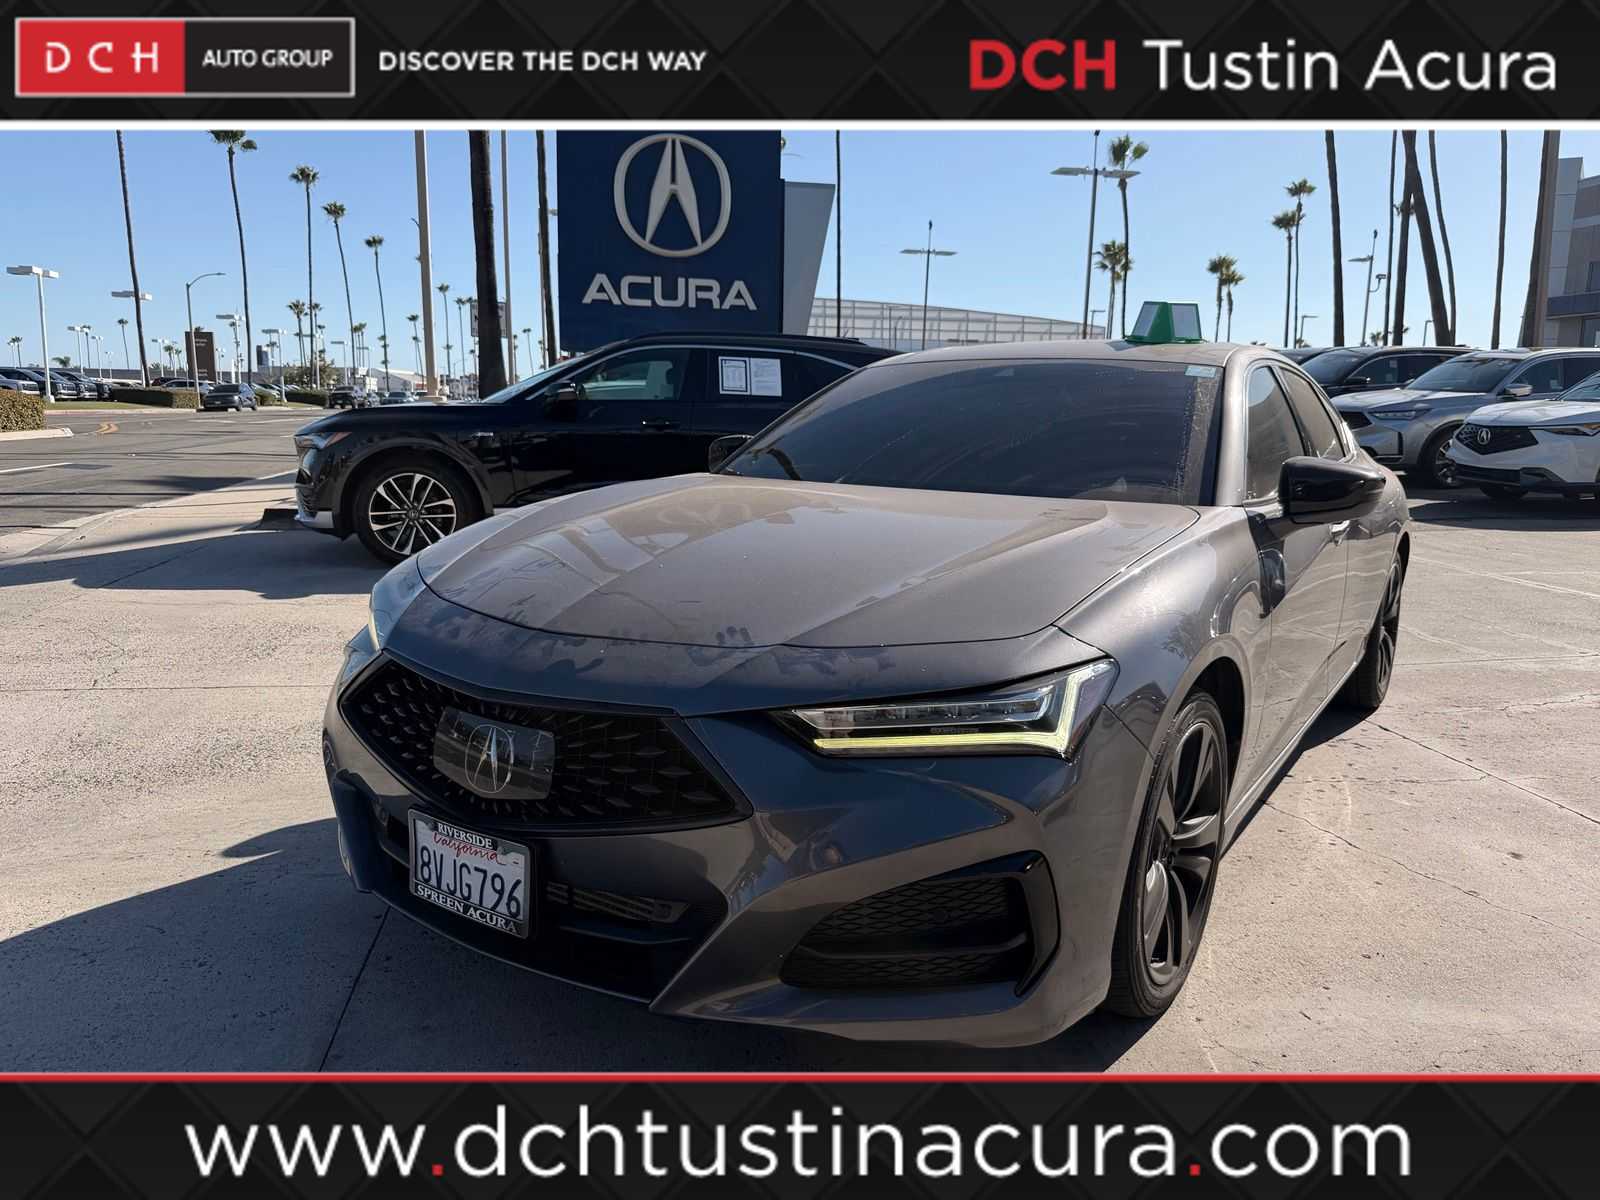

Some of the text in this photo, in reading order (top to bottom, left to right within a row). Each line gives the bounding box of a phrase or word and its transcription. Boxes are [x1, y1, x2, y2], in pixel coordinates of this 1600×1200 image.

[582, 273, 757, 311] ACURA
[437, 822, 494, 849] RIVERSIDE
[420, 845, 522, 919] 8VJG796
[416, 885, 518, 935] SPREEN ACURA
